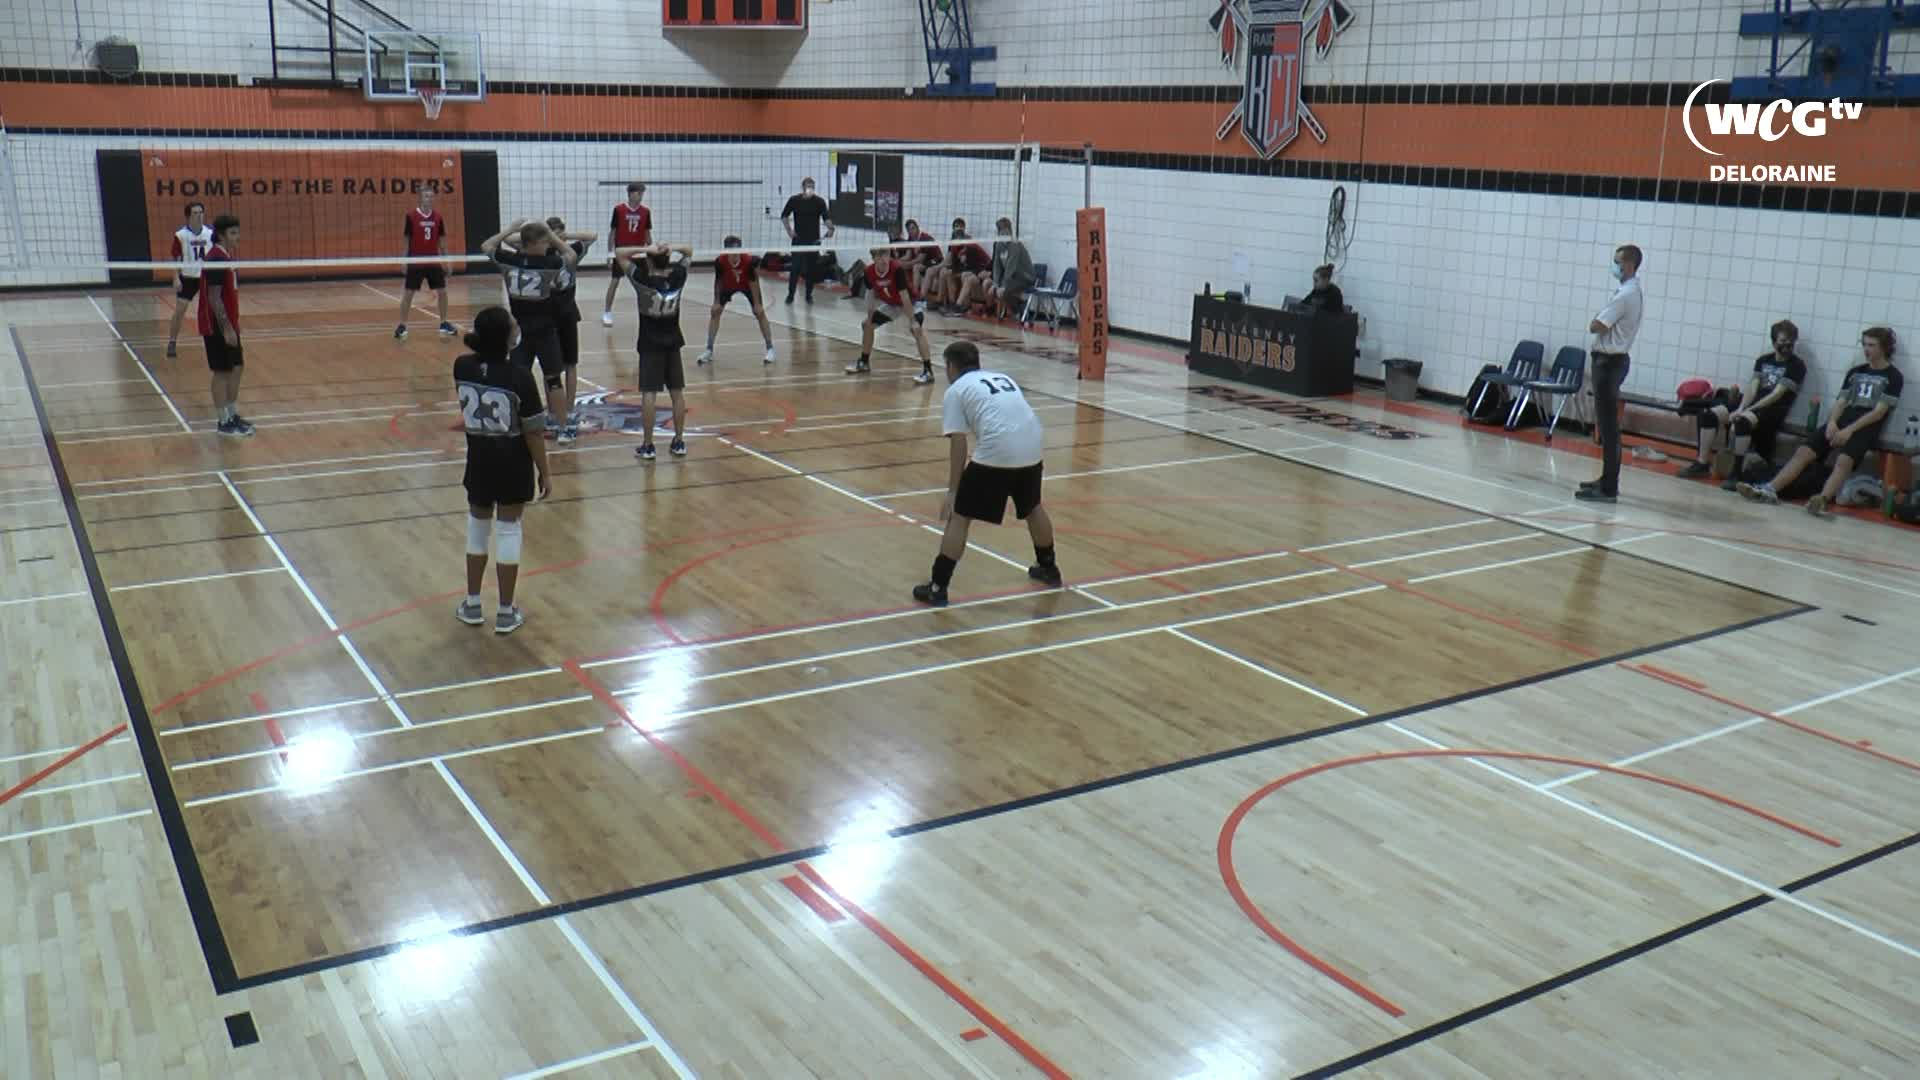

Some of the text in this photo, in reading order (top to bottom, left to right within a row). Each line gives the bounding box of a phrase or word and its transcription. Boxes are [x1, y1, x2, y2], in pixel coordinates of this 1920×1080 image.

[156, 177, 456, 197] HOME OF THE RAIDERS
[506, 267, 544, 297] 12
[1089, 231, 1104, 356] RAIDERS
[1199, 327, 1297, 373] RAIDERS
[457, 384, 512, 433] 23
